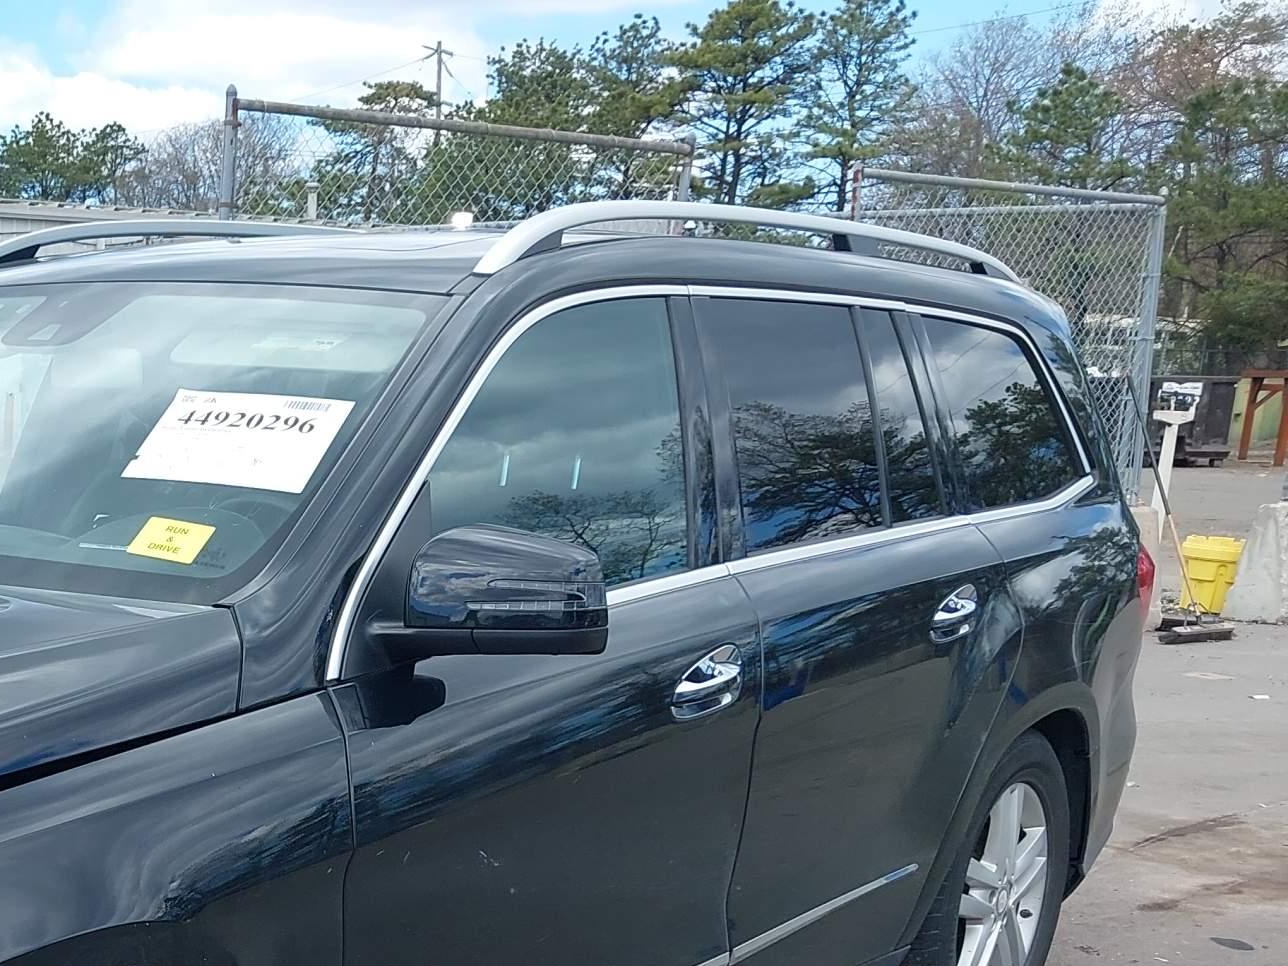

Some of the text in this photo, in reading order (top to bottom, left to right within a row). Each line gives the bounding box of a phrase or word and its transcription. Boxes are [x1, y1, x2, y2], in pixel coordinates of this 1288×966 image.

[177, 409, 318, 434] 44920296
[165, 525, 190, 536] RUN
[146, 542, 182, 554] DRIVE
